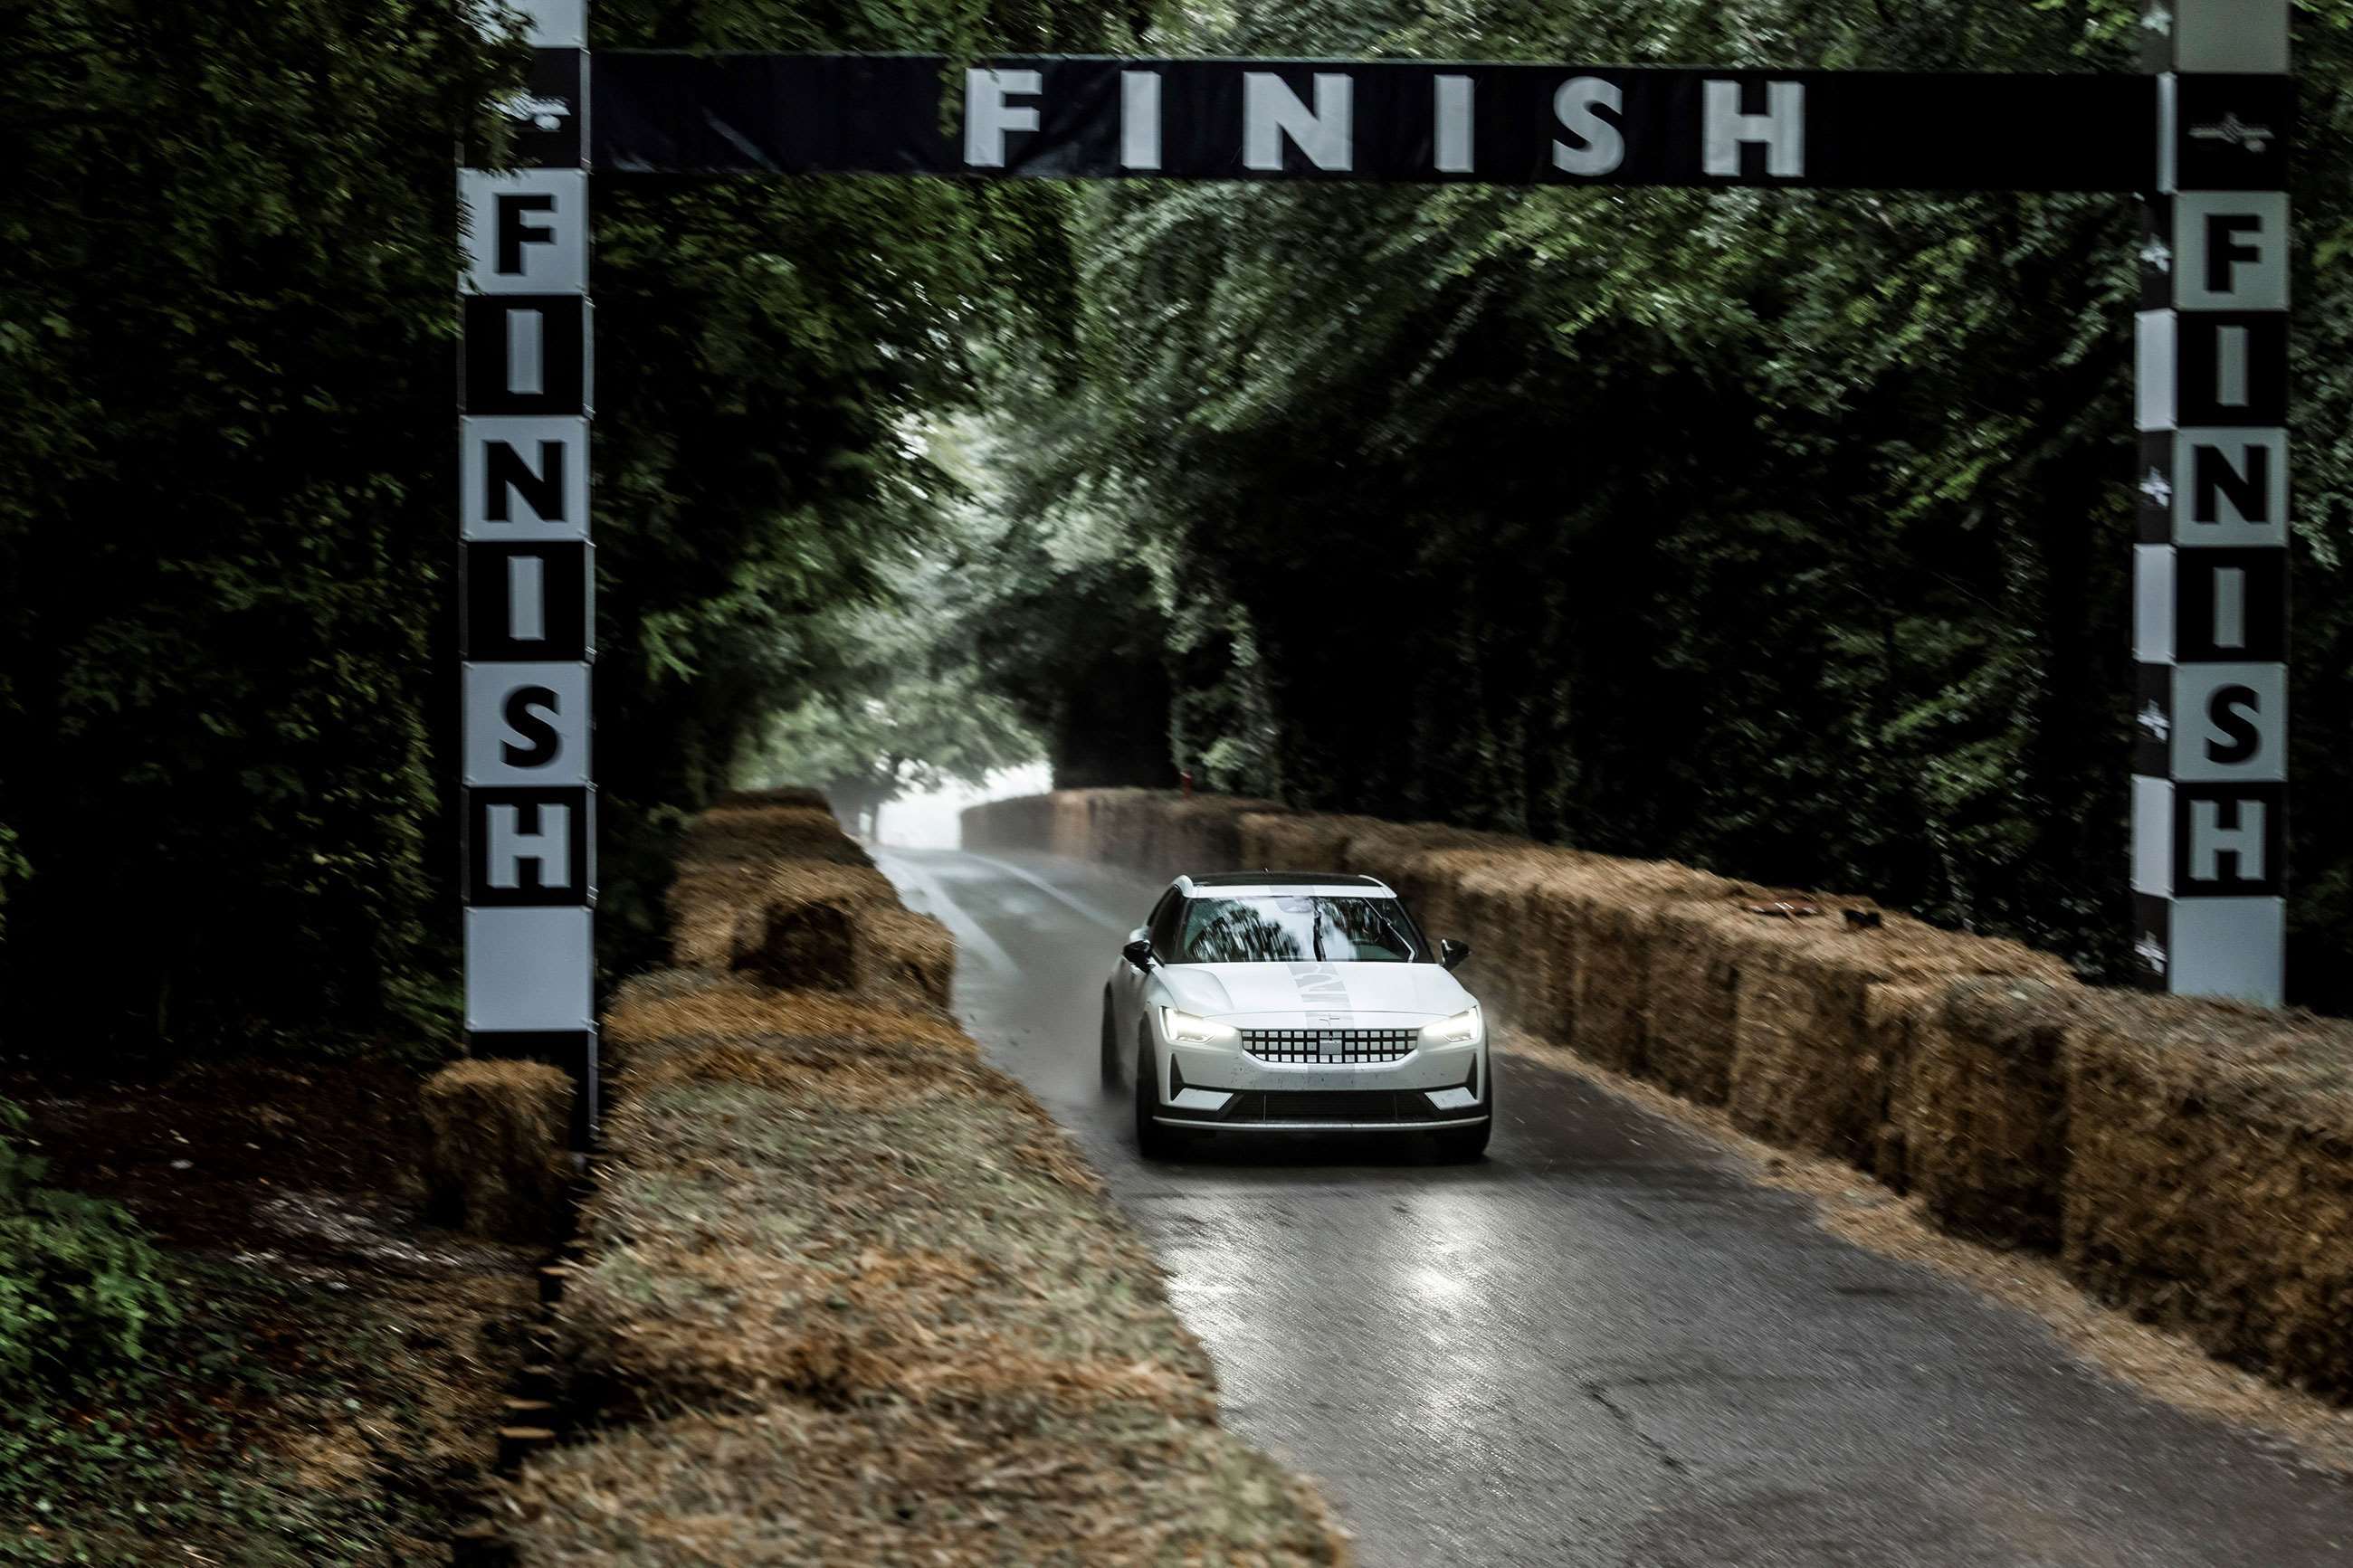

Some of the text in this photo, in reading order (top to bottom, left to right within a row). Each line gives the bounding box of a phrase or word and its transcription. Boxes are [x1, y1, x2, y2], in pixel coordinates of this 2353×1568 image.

[963, 69, 1805, 177] FINISH
[481, 193, 571, 889] FINISH
[2189, 213, 2270, 881] FINISH
